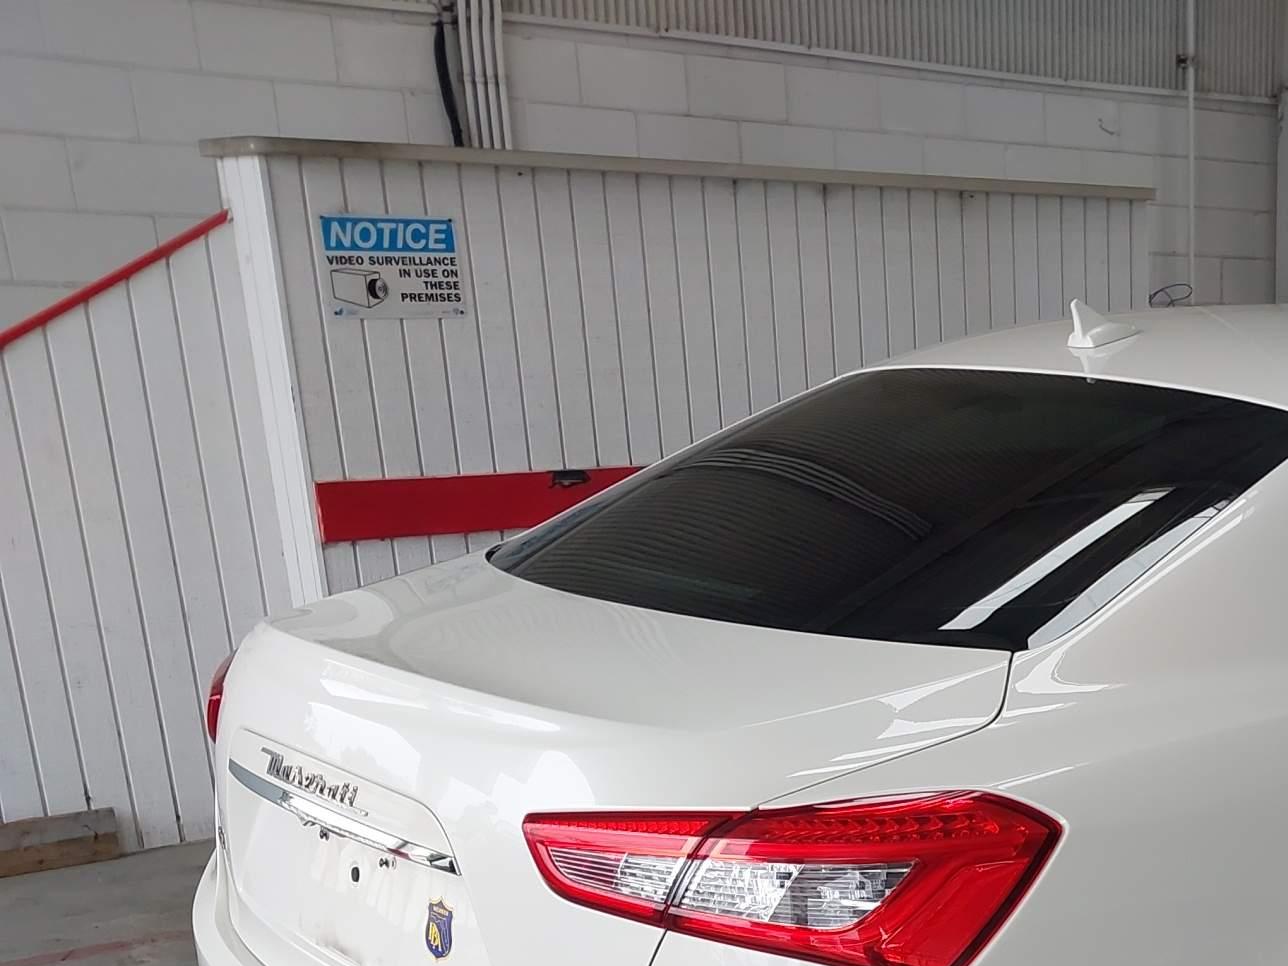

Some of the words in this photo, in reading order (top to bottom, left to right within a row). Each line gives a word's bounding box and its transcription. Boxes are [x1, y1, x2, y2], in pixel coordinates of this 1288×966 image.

[330, 221, 447, 249] NOTICE
[326, 255, 364, 266] VIDEO
[368, 256, 457, 267] SURVEILLANCE
[399, 269, 411, 278] IN
[415, 269, 438, 278] USE
[442, 269, 458, 278] ON
[423, 281, 460, 291] THESE
[401, 292, 462, 303] PREMISES
